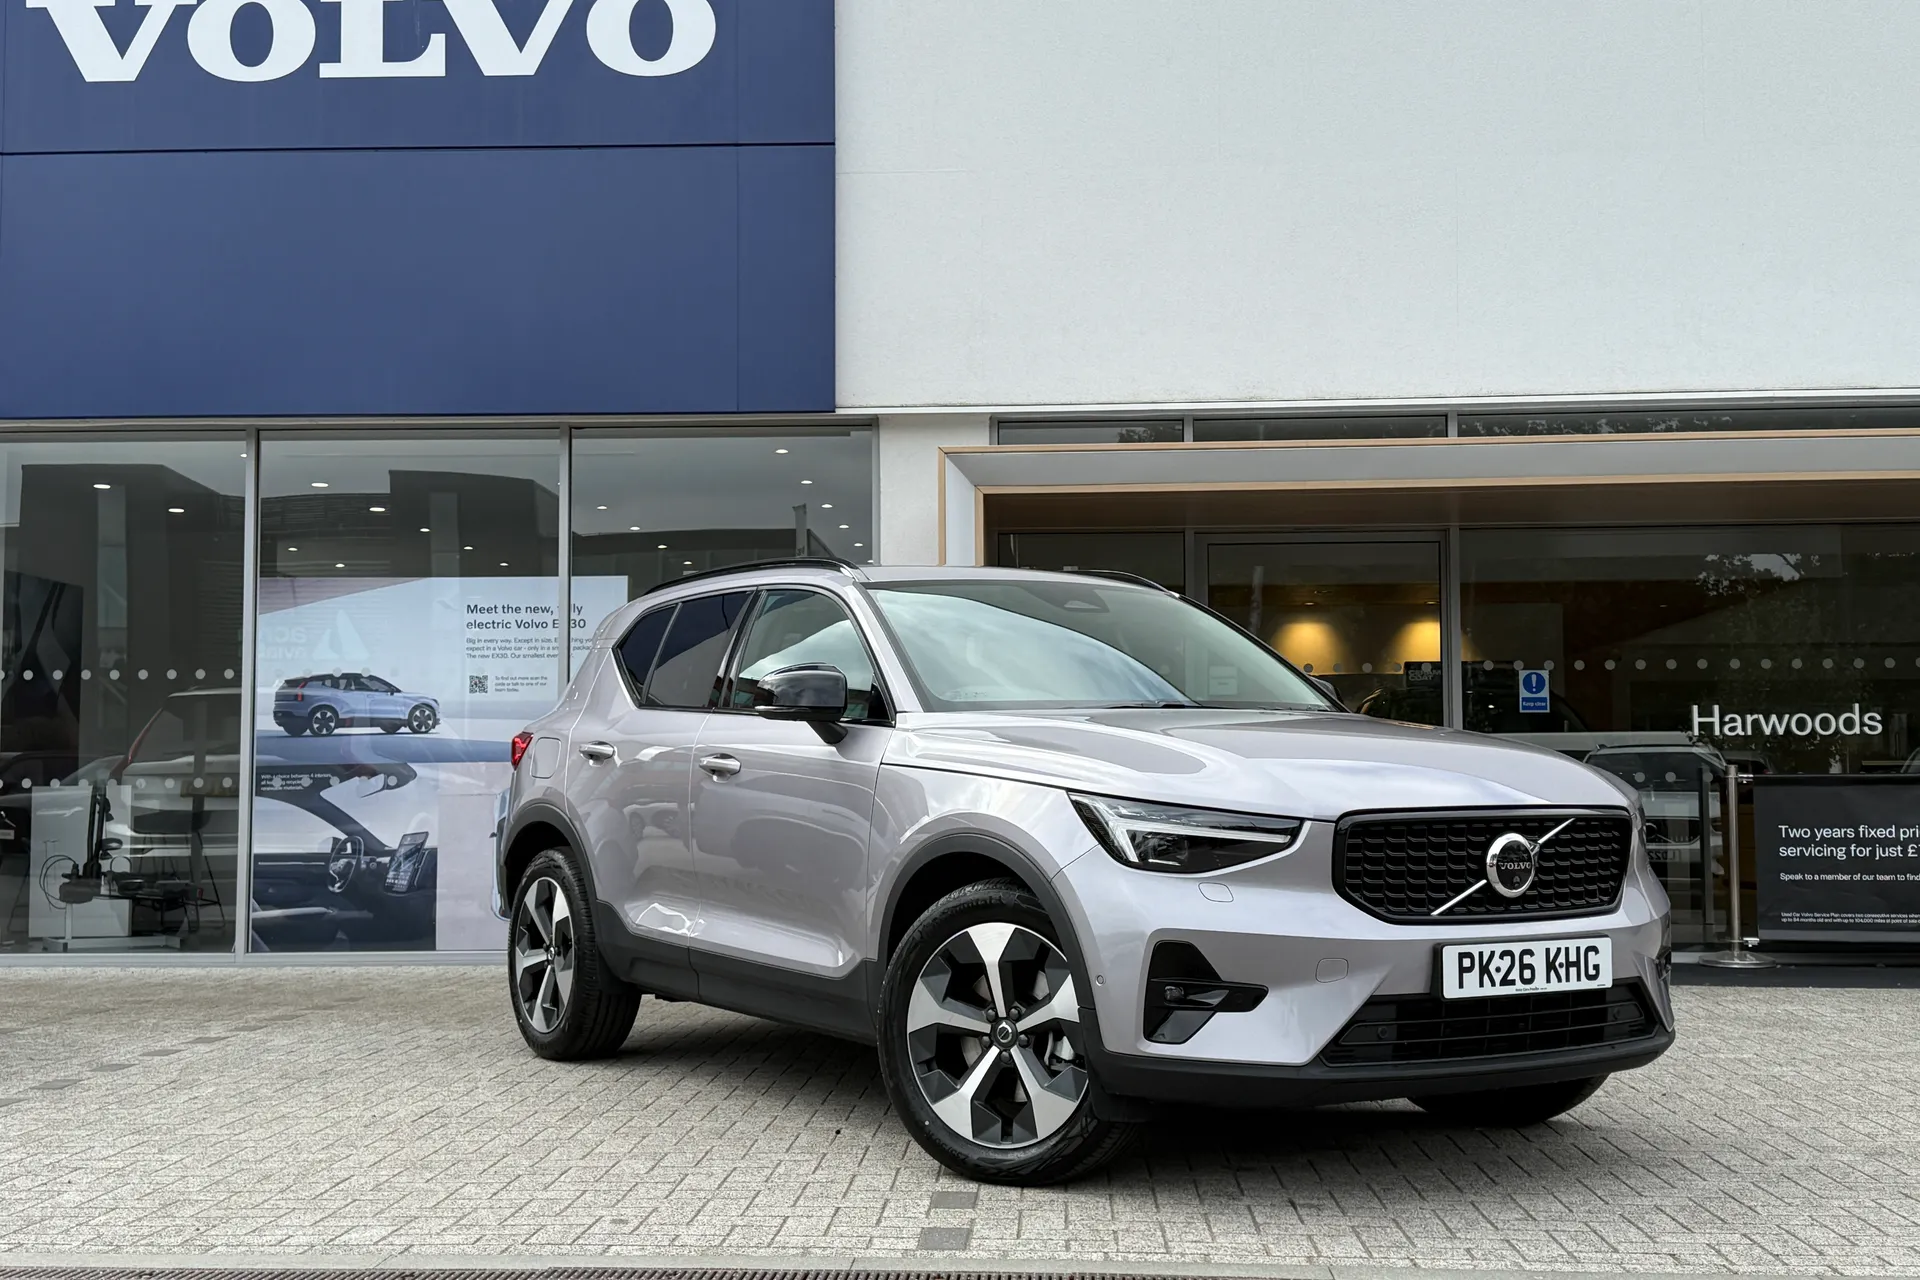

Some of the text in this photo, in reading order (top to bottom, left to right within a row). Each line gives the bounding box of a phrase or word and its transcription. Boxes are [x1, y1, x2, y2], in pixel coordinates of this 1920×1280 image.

[25, 0, 717, 82] VOLVO
[466, 604, 498, 614] Meet
[502, 603, 521, 614] the
[525, 605, 554, 616] new,
[466, 618, 586, 629] electric Volvo E30
[514, 637, 533, 645] Except
[1691, 703, 1883, 736] Harwoods
[1778, 825, 1920, 841] Two years fixed pri
[1779, 844, 1847, 860] servicing
[1850, 843, 1872, 857] for
[1875, 844, 1903, 860] just
[1498, 861, 1532, 870] VOLVO
[1779, 872, 1804, 881] Speak
[1458, 945, 1601, 989] PK26 KHG
